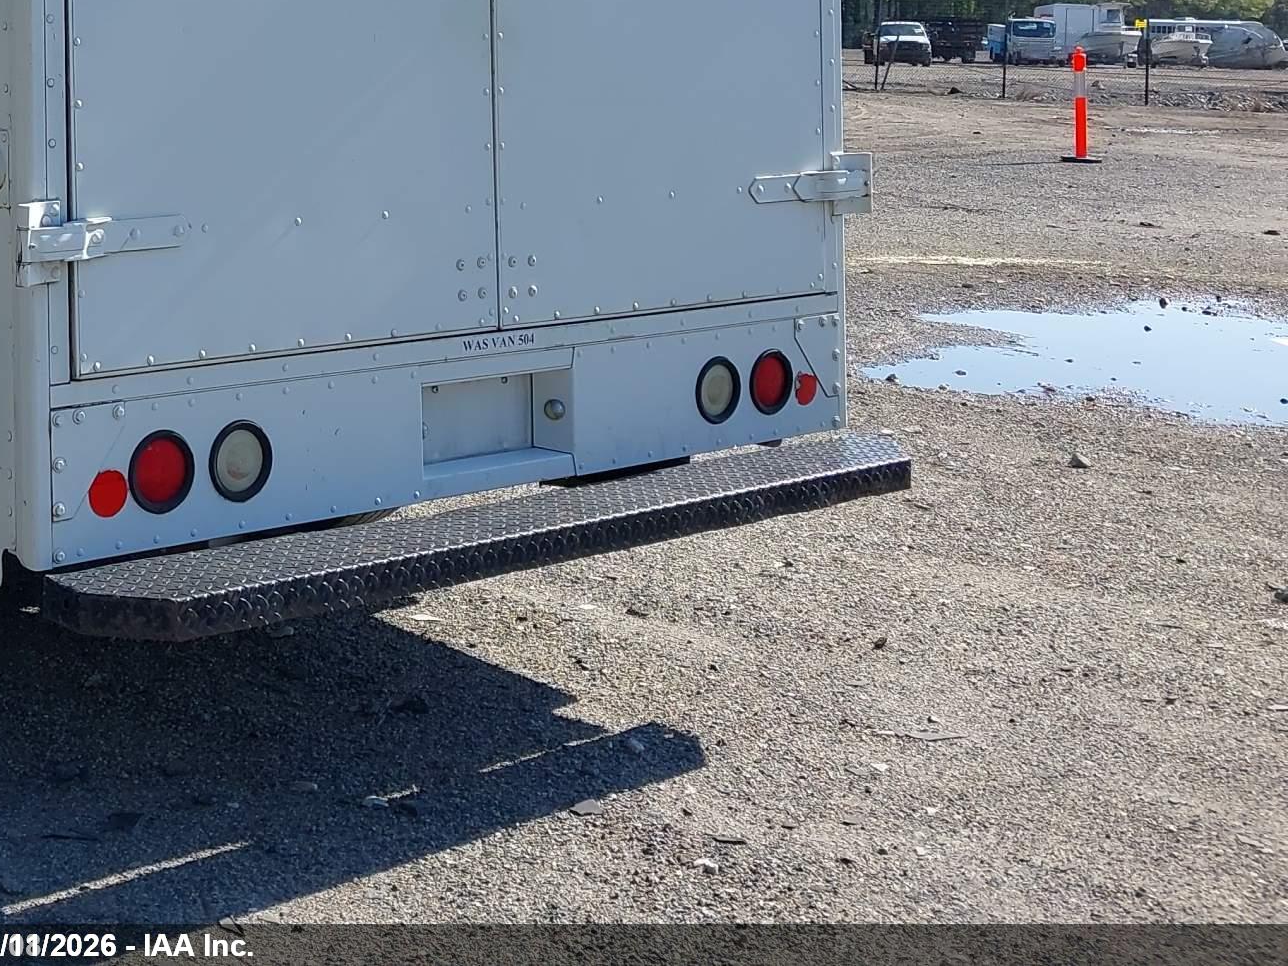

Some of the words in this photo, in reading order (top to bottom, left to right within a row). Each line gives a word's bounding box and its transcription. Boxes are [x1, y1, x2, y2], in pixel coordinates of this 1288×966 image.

[462, 337, 489, 352] WAS
[491, 335, 516, 349] VAN
[518, 332, 535, 346] 504
